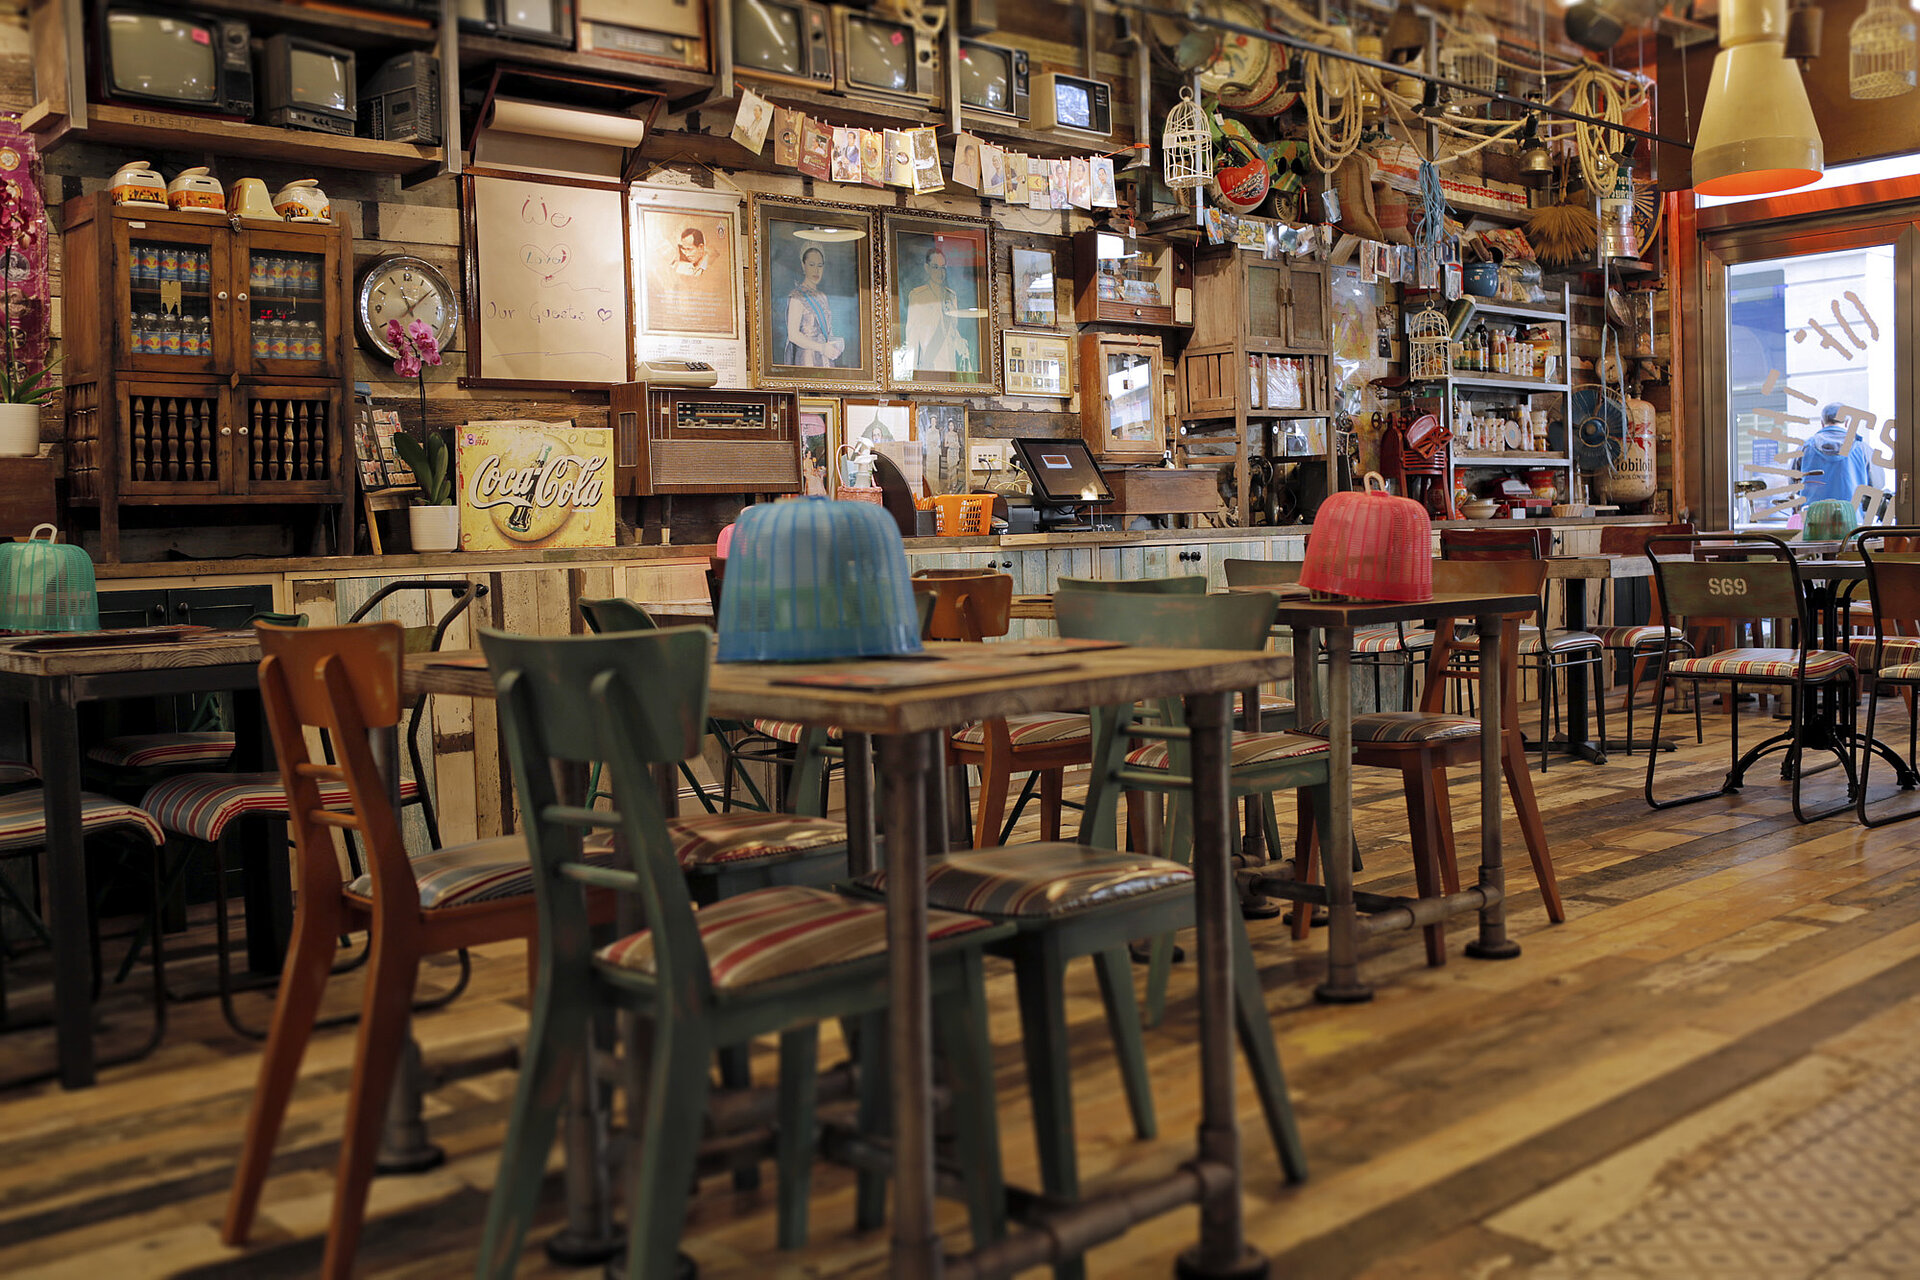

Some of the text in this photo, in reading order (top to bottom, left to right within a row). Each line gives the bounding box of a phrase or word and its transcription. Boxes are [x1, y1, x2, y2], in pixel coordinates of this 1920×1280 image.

[132, 114, 201, 130] FIRESTOP
[521, 194, 572, 228] We
[485, 301, 516, 320] Our
[1708, 577, 1748, 596] S69
